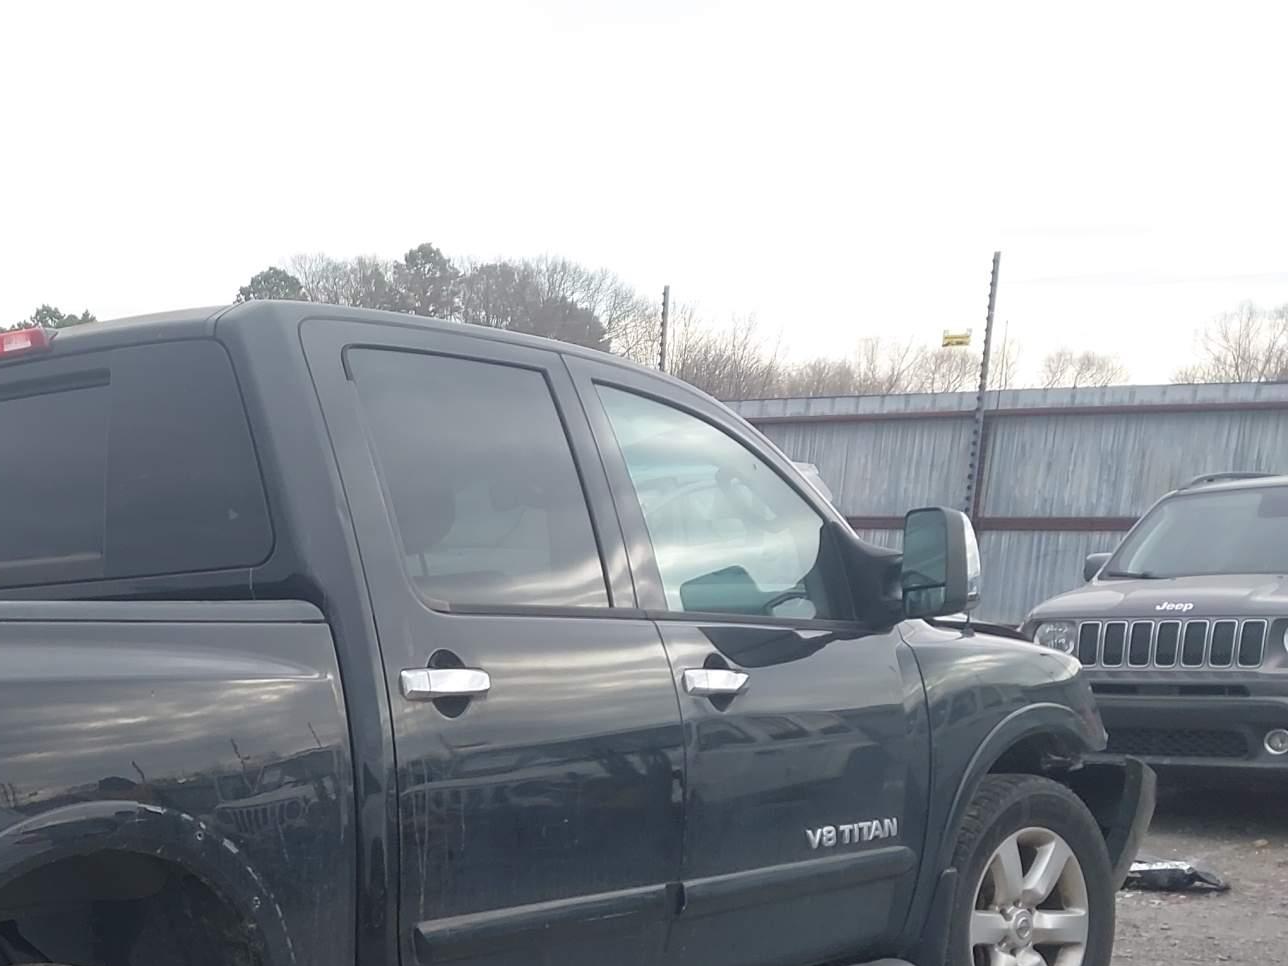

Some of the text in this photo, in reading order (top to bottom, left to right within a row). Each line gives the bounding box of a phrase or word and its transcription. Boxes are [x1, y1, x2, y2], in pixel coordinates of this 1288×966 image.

[1155, 601, 1194, 612] Jeep
[806, 817, 898, 849] V8 TITAN
